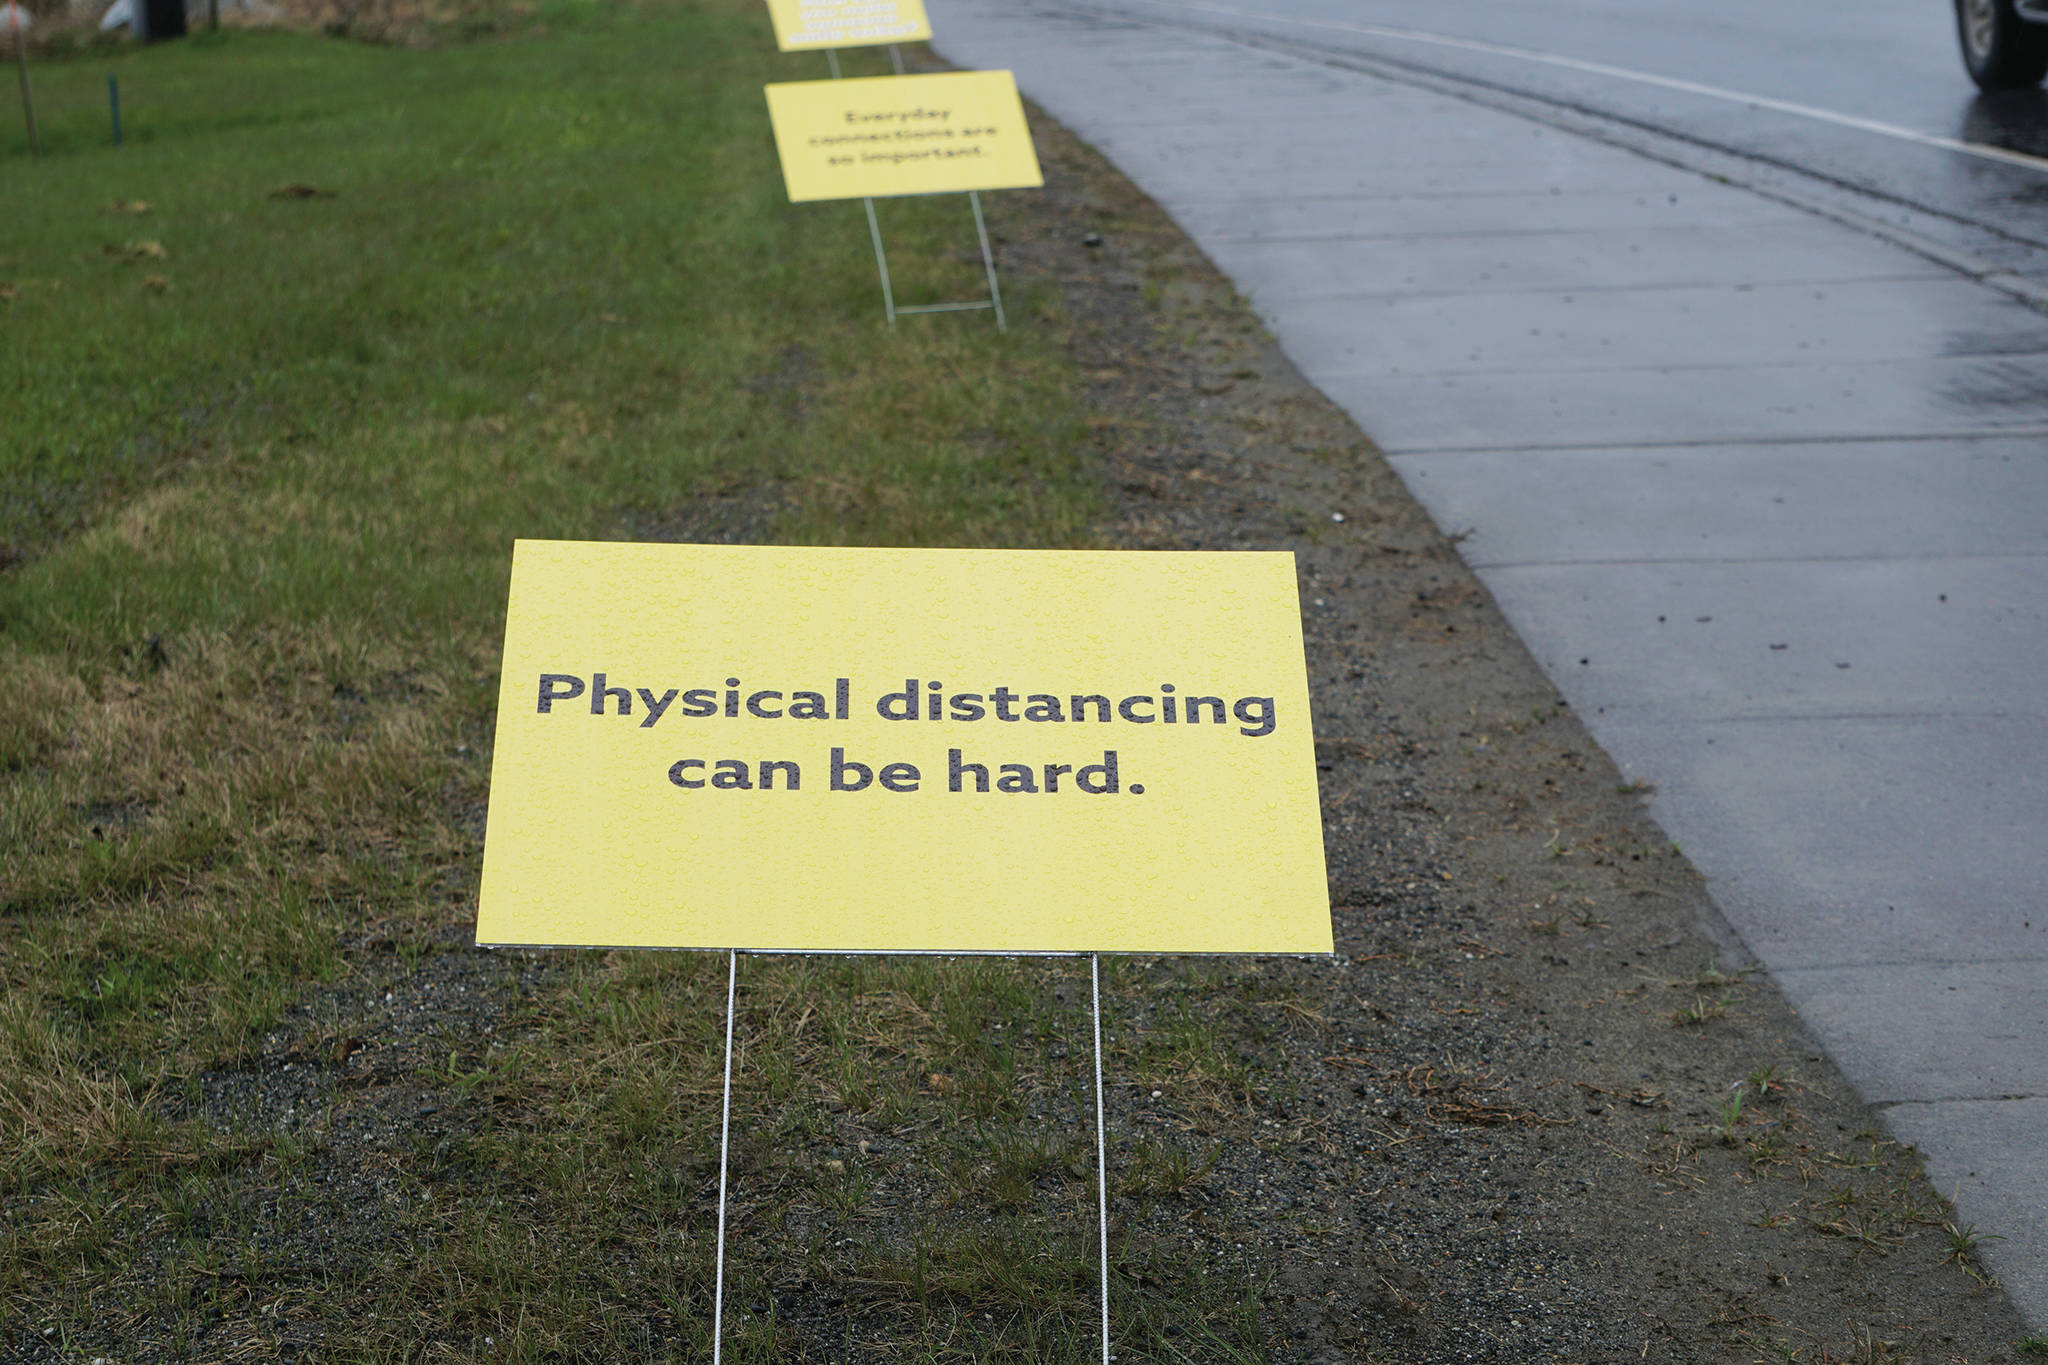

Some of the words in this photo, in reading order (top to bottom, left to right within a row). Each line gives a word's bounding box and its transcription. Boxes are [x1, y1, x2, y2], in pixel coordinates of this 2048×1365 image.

[845, 107, 951, 124] Everyday
[809, 129, 954, 146] connections
[962, 126, 997, 138] are
[537, 673, 849, 727] Physical
[877, 679, 1276, 737] distancing
[668, 759, 800, 791] can
[830, 748, 920, 792] be
[949, 749, 1145, 794] hard.
